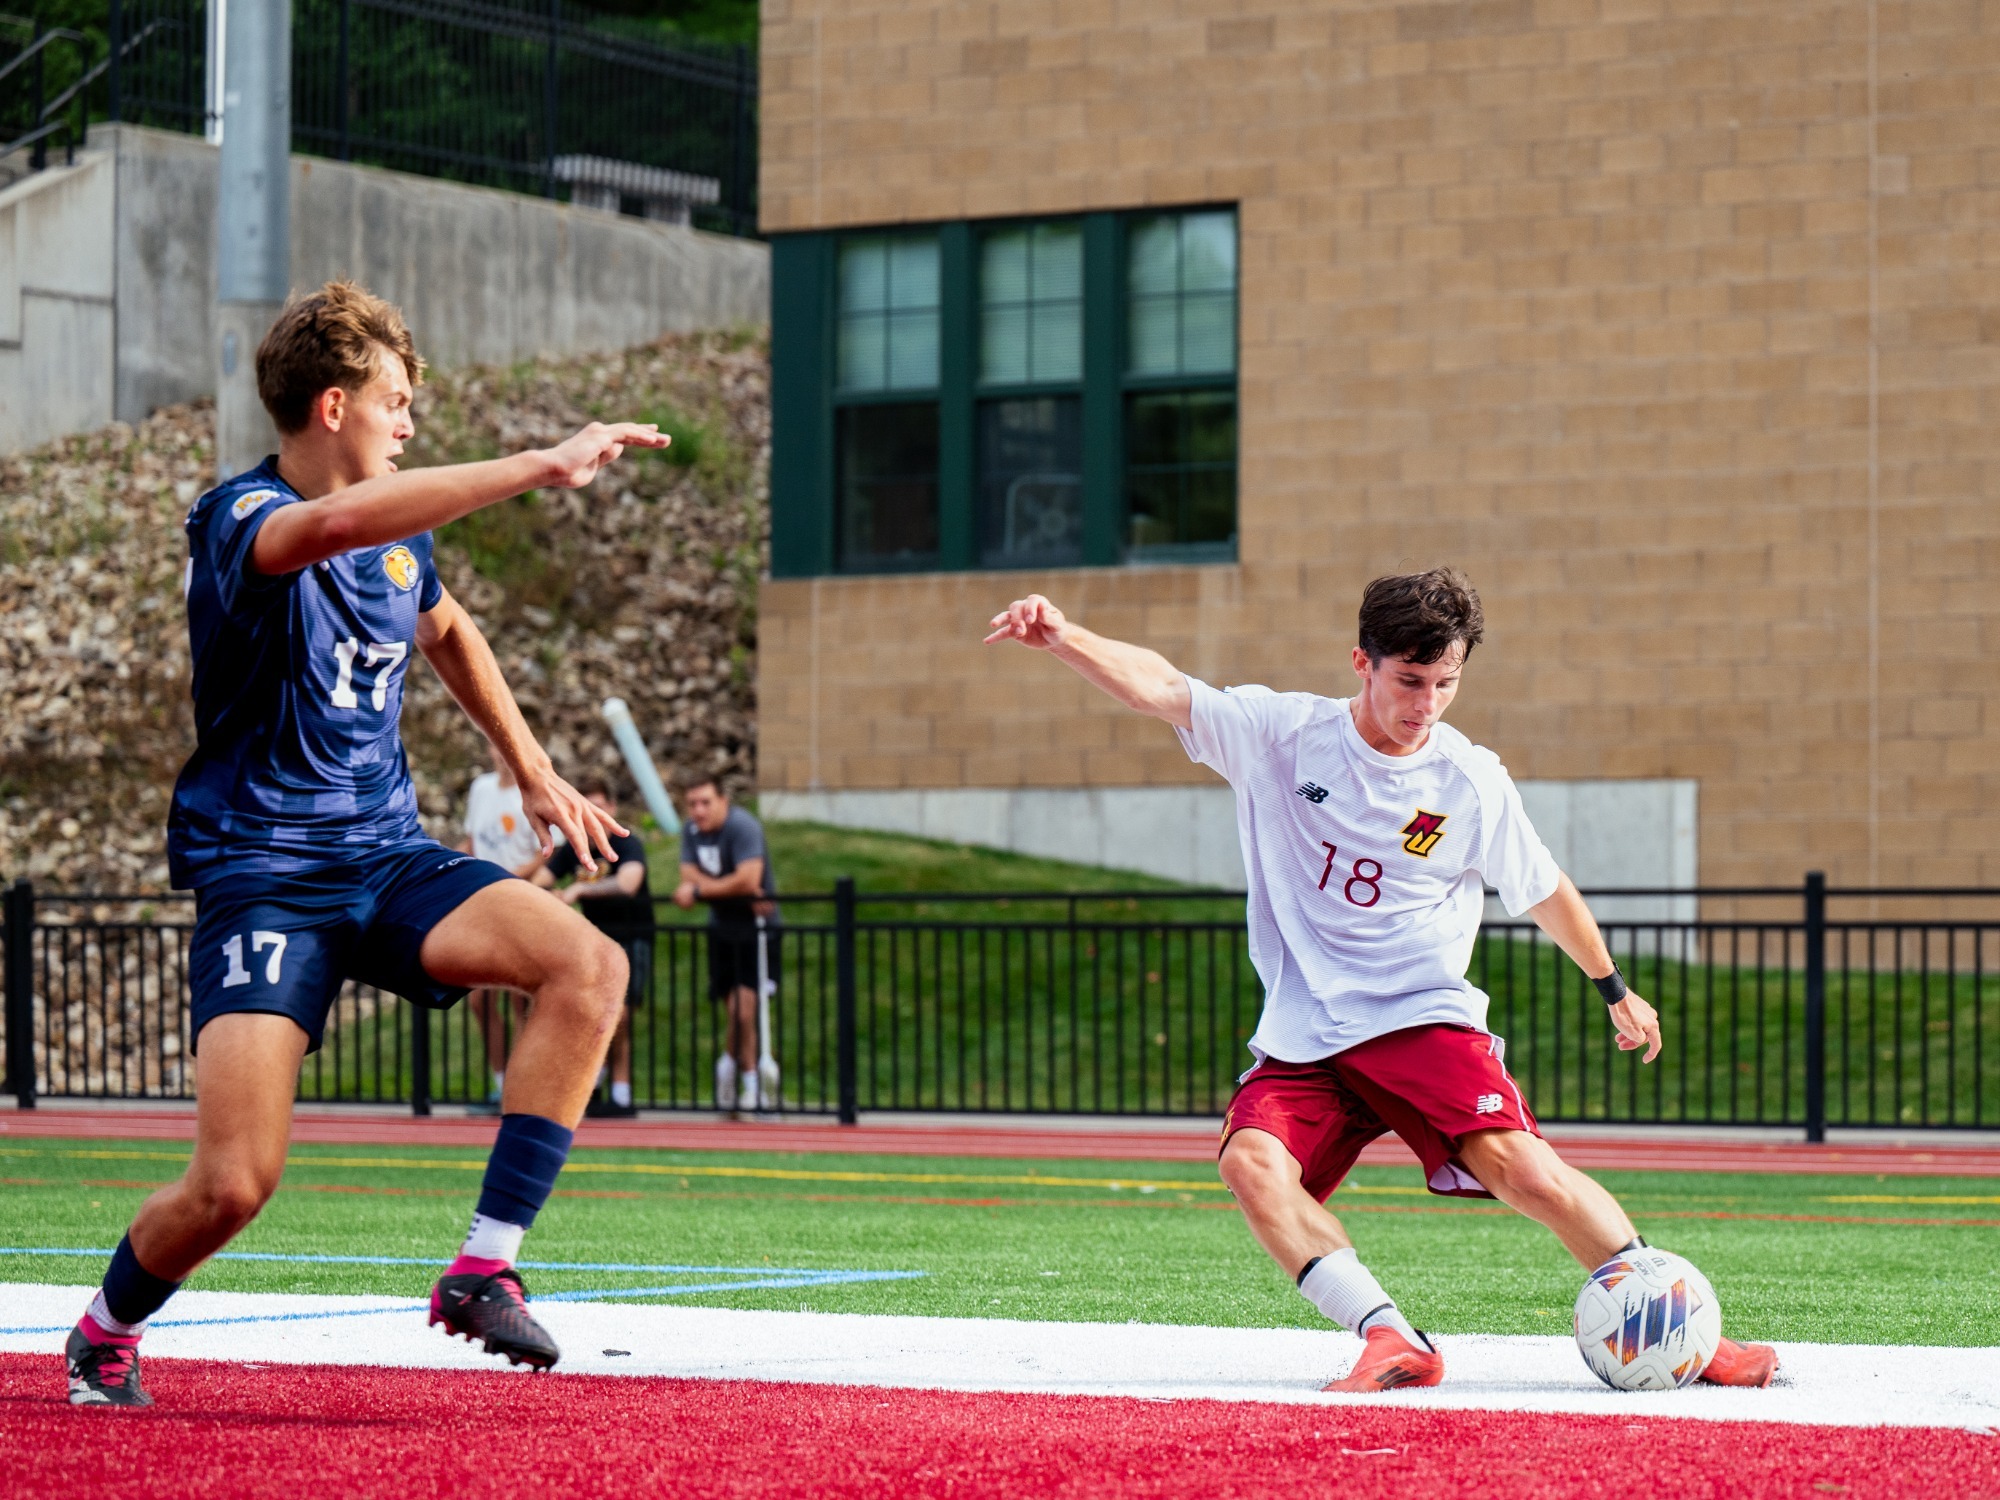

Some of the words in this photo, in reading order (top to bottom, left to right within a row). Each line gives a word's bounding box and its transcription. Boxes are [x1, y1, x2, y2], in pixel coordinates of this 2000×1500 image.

[330, 637, 407, 712] 17
[1317, 840, 1383, 908] 18
[221, 931, 288, 989] 17
